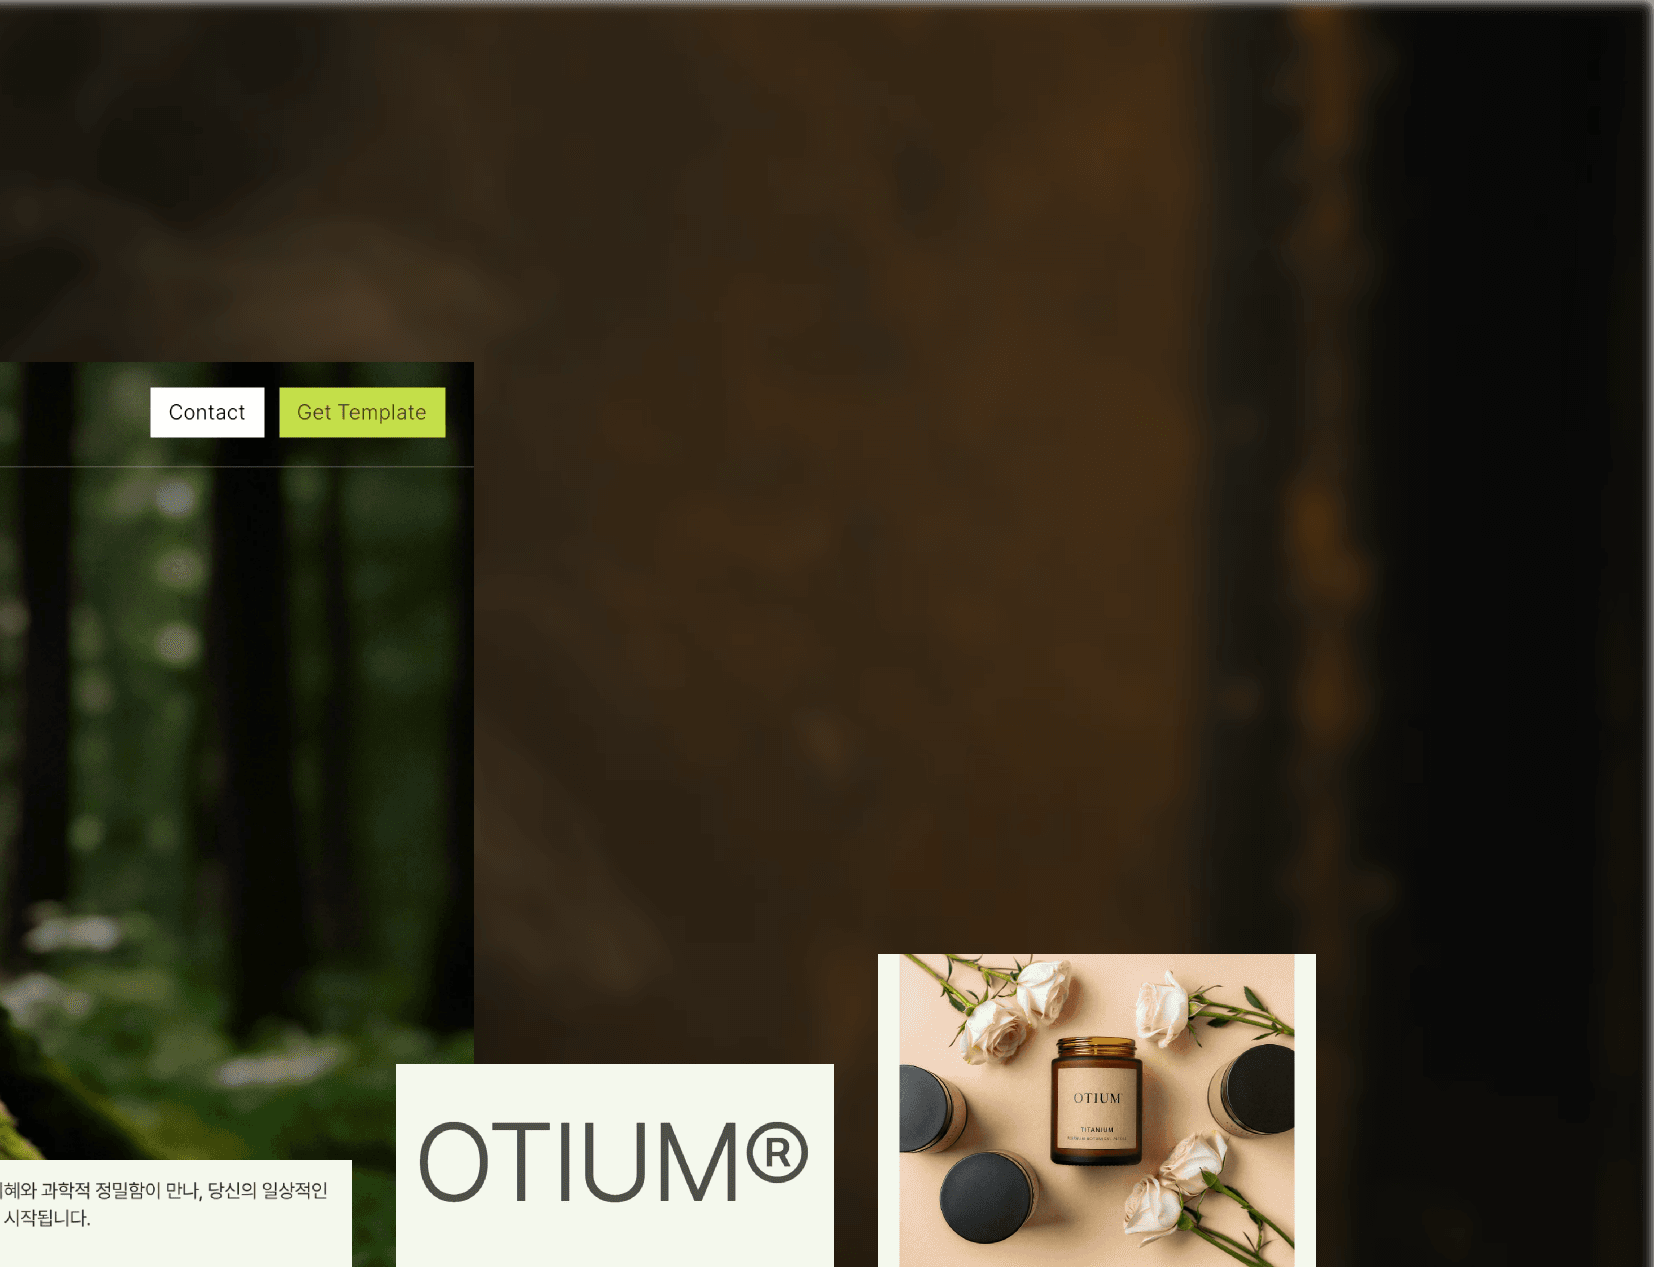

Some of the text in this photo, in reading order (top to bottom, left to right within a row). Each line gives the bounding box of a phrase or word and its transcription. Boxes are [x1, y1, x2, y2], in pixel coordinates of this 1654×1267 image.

[169, 403, 245, 421] Contact
[297, 403, 427, 425] Get Template
[1074, 1093, 1122, 1103] OTIUM
[419, 1121, 809, 1203] OTIUM®
[41, 1181, 90, 1200] 과학적
[95, 1181, 160, 1200] 정밀함이
[166, 1181, 203, 1202] 만나,
[208, 1181, 256, 1200] 당신의
[262, 1181, 327, 1200] 일상적인
[3, 1208, 91, 1228] 시작됩니다.
